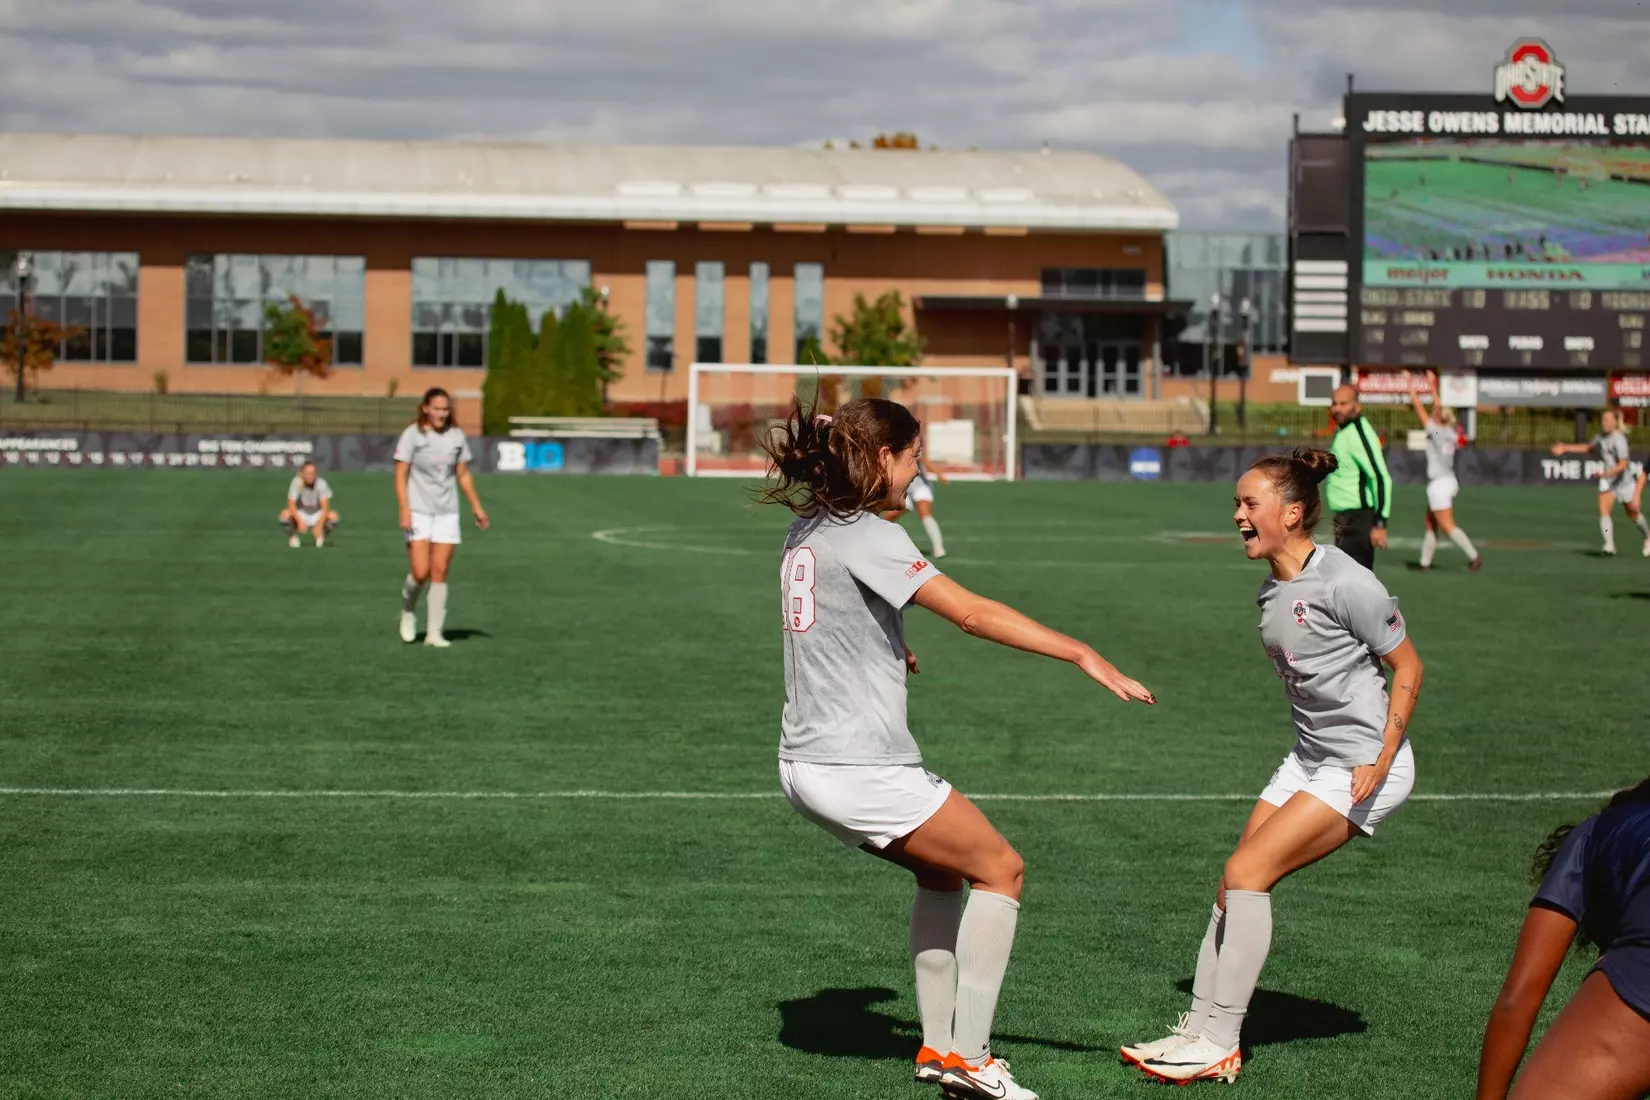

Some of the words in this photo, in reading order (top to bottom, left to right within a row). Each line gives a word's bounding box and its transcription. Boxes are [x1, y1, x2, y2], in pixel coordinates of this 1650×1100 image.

[1363, 111, 1425, 133] JESSE
[1428, 111, 1500, 134] OWENS
[1504, 112, 1610, 135] MEMORIAL
[1613, 113, 1650, 136] STA
[1486, 268, 1584, 282] HONDA
[1541, 459, 1581, 479] THE
